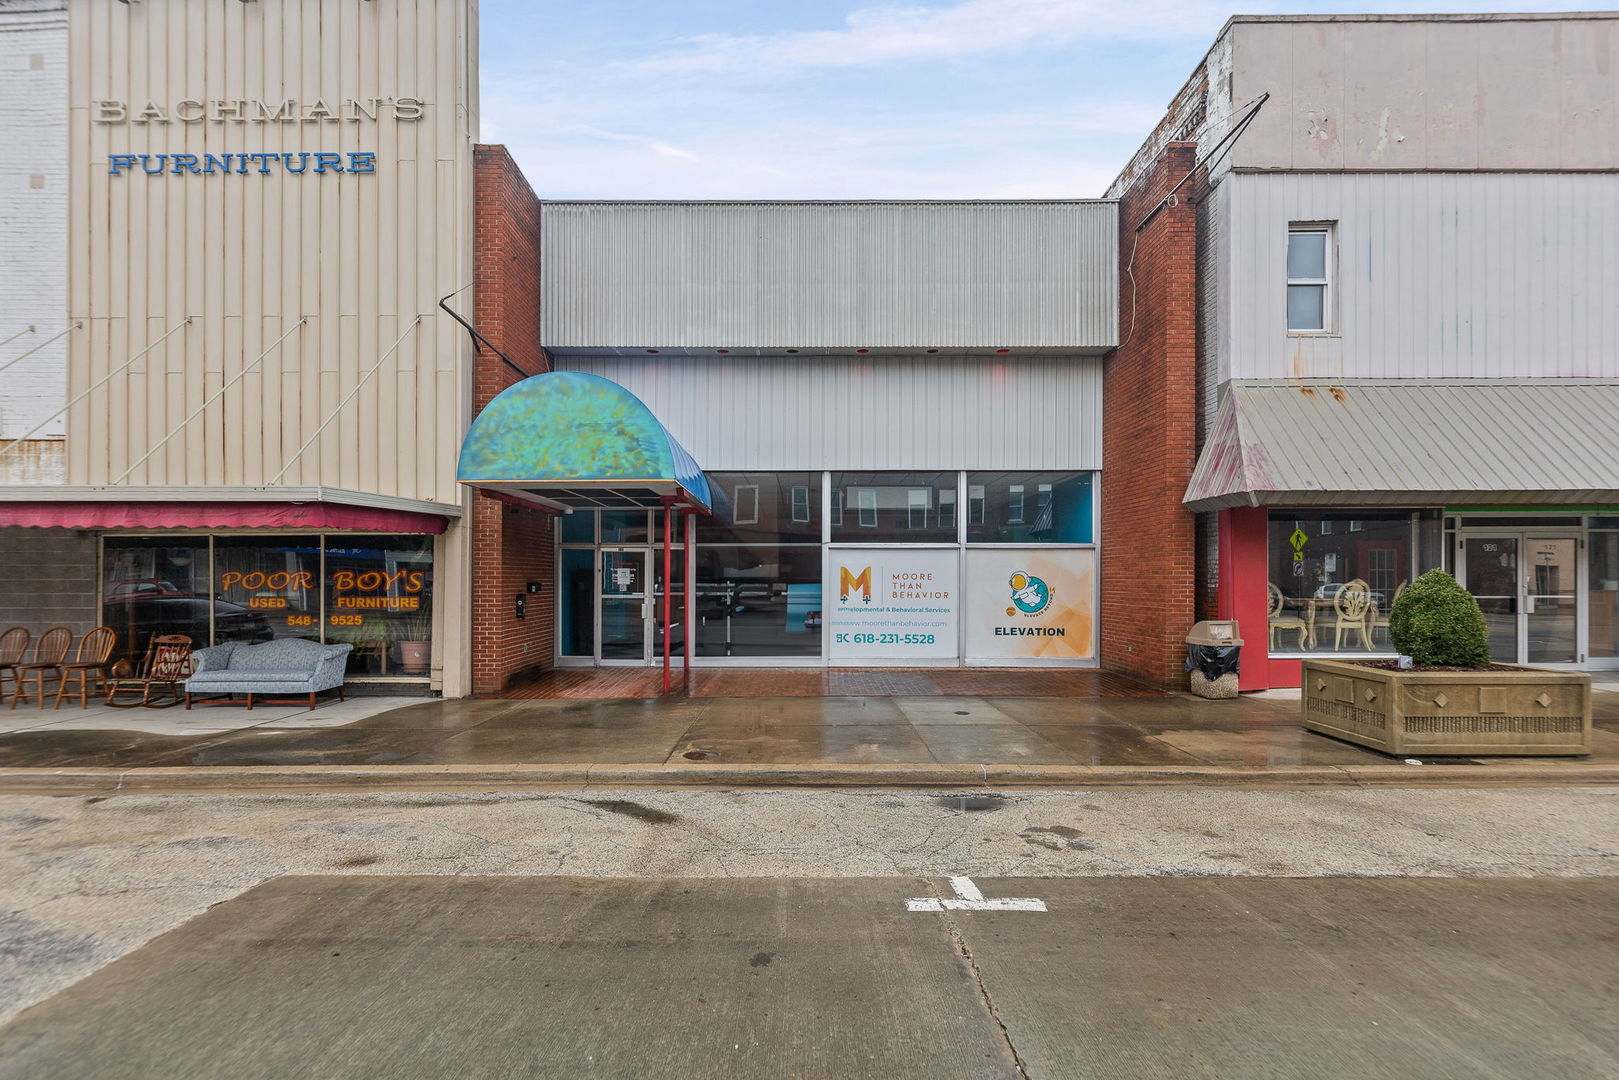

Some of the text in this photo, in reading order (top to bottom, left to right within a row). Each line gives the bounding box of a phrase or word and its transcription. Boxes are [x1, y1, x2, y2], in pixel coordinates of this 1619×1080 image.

[92, 95, 426, 124] BACHMAN'S
[107, 152, 376, 175] FURNITURE
[220, 569, 425, 592] POOR BOY'S
[892, 573, 933, 581] MOORE
[892, 582, 923, 590] THAN
[892, 591, 949, 599] BEHAVIOR
[249, 597, 420, 608] USED FURNITURE
[330, 615, 364, 626] 9525
[994, 627, 1066, 637] ELEVATION
[853, 633, 936, 645] 618-231-5528
